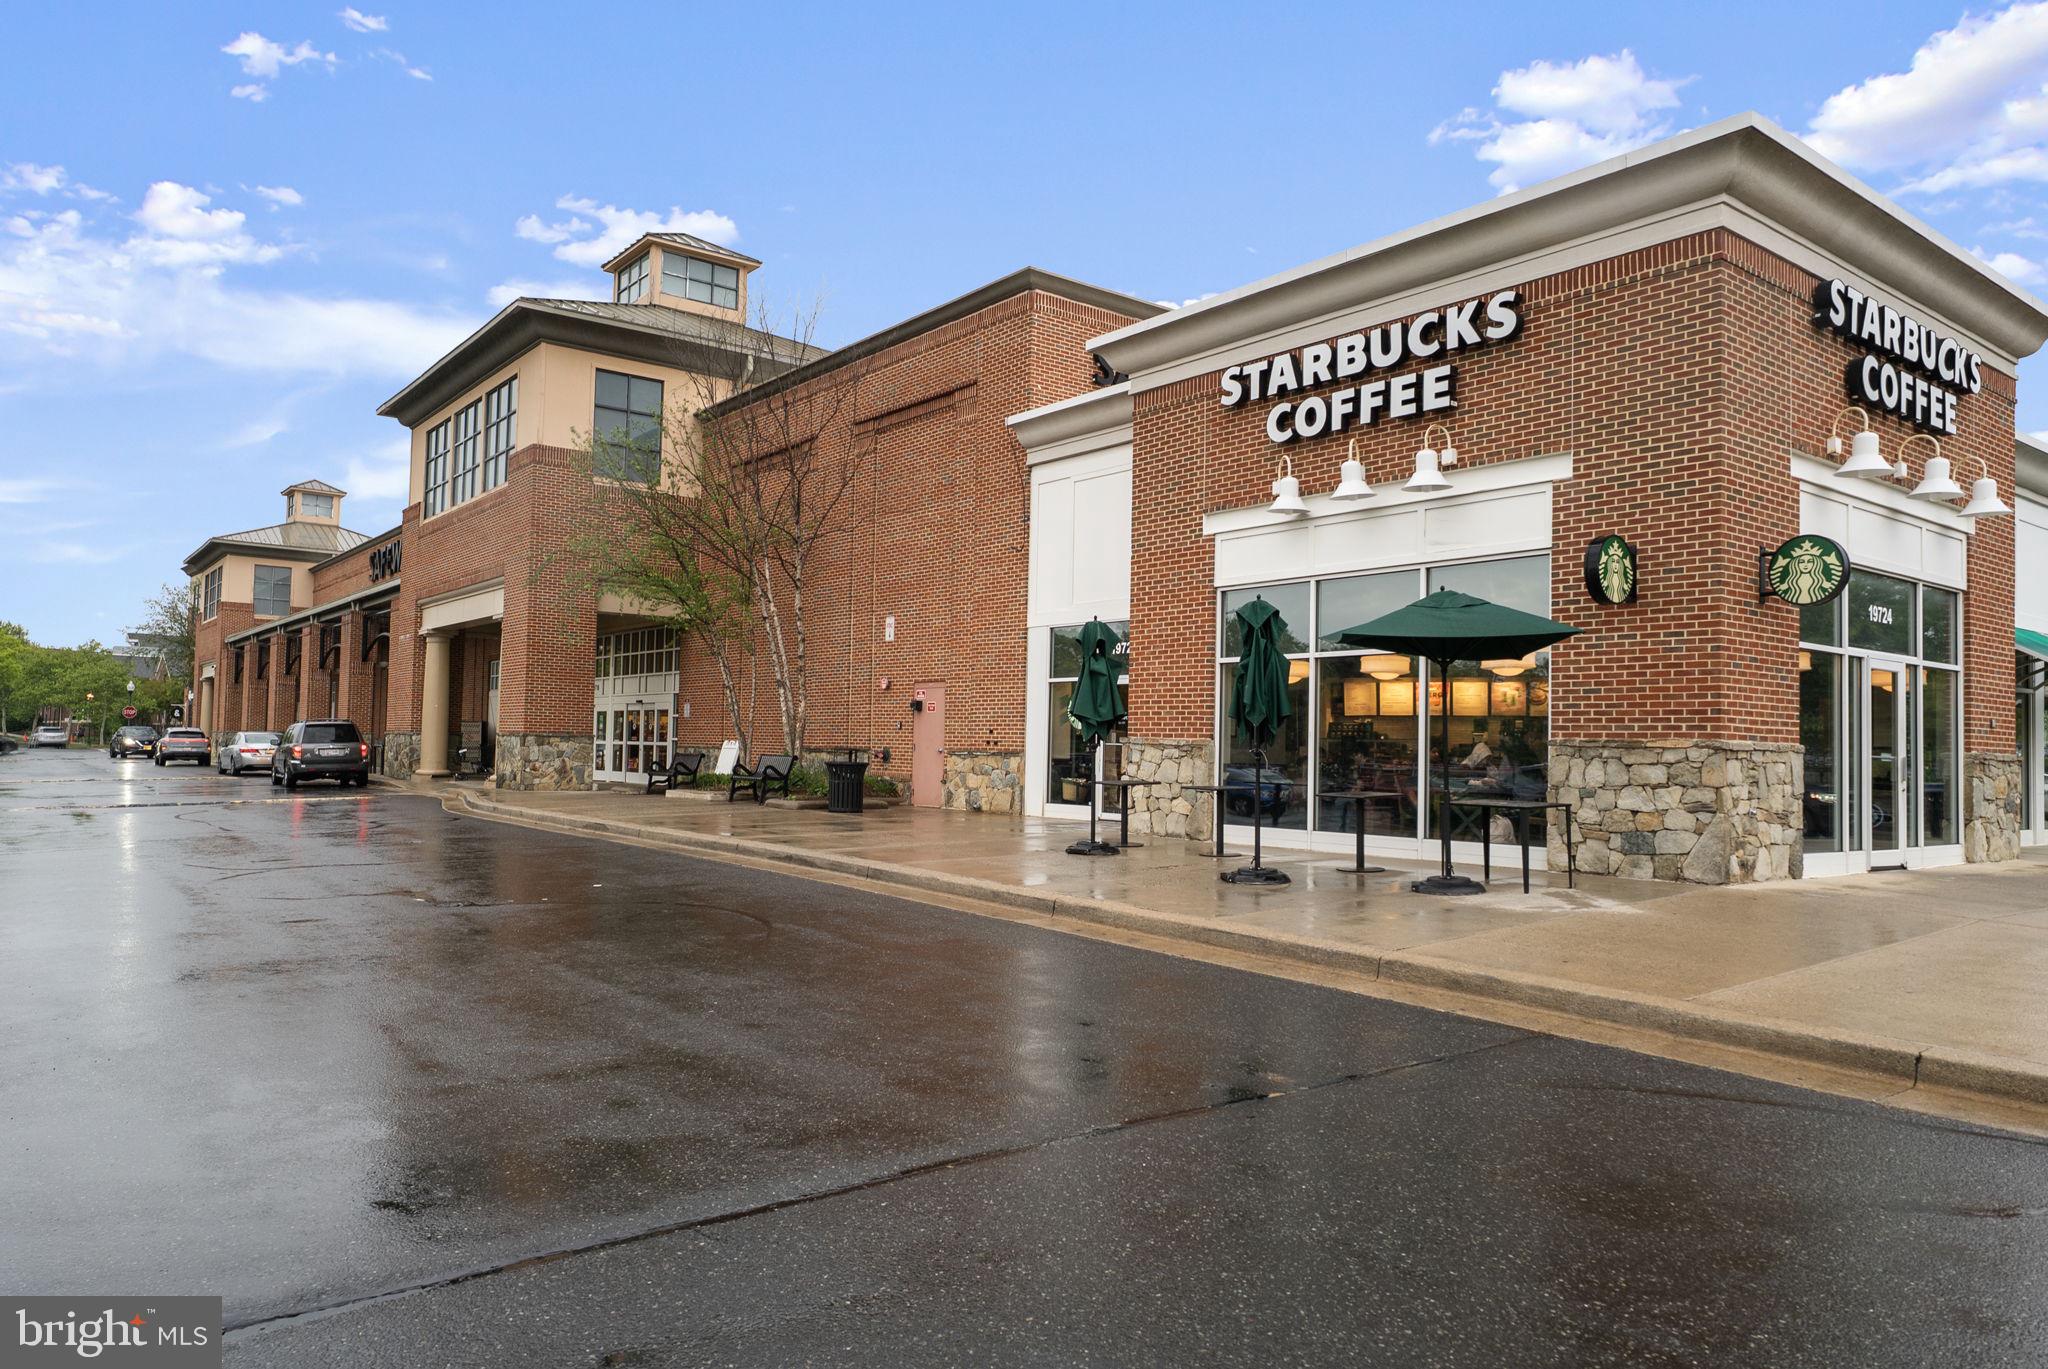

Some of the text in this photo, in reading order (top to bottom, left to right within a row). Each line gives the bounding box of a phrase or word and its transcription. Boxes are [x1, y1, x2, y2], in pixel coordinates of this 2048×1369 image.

[1220, 291, 1518, 406] STARBUCKS
[1830, 278, 1983, 395] STARBUCKS
[1266, 365, 1451, 443] COFFEE
[1862, 354, 1958, 435] COFFEE
[1868, 604, 1893, 625] 19724
